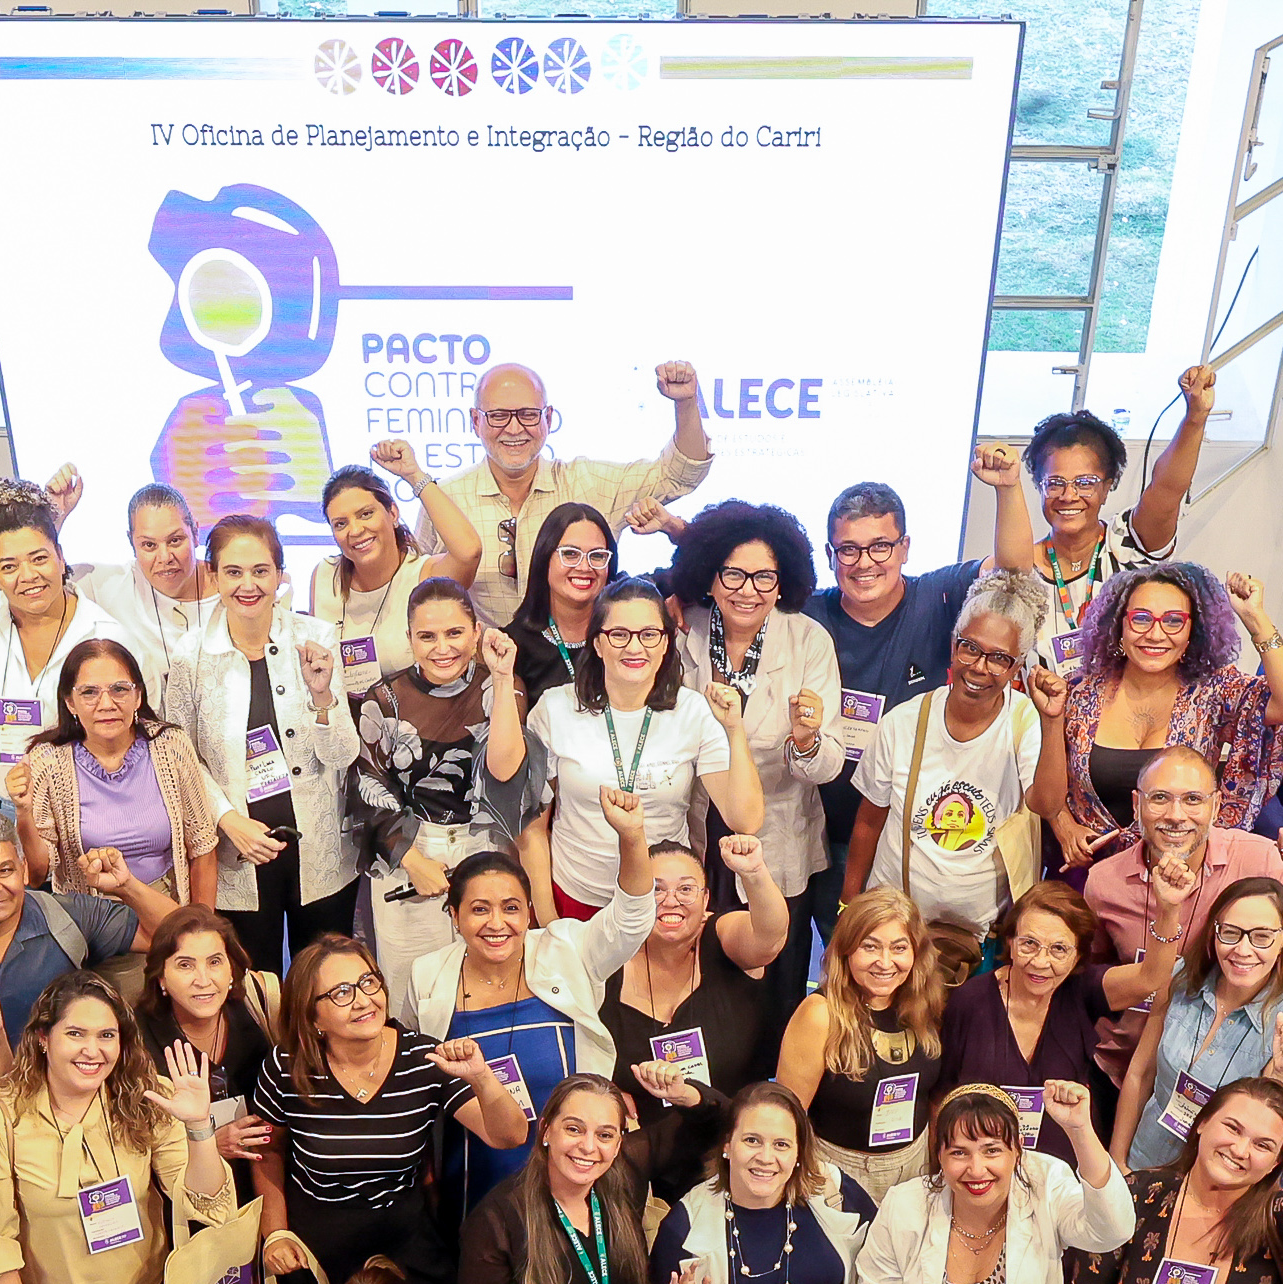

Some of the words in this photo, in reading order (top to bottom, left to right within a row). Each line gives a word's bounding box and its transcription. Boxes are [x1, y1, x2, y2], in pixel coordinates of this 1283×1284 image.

[151, 123, 174, 146] IV
[182, 123, 265, 147] Oficina
[272, 124, 298, 147] de
[306, 123, 460, 152] Planejamento
[467, 129, 479, 147] e
[487, 124, 610, 152] Integração
[638, 124, 713, 153] Região
[721, 126, 749, 148] do
[756, 124, 821, 148] Cariri
[361, 332, 491, 366] PACTO
[364, 371, 478, 398] CONTR
[979, 797, 997, 824] TEUS
